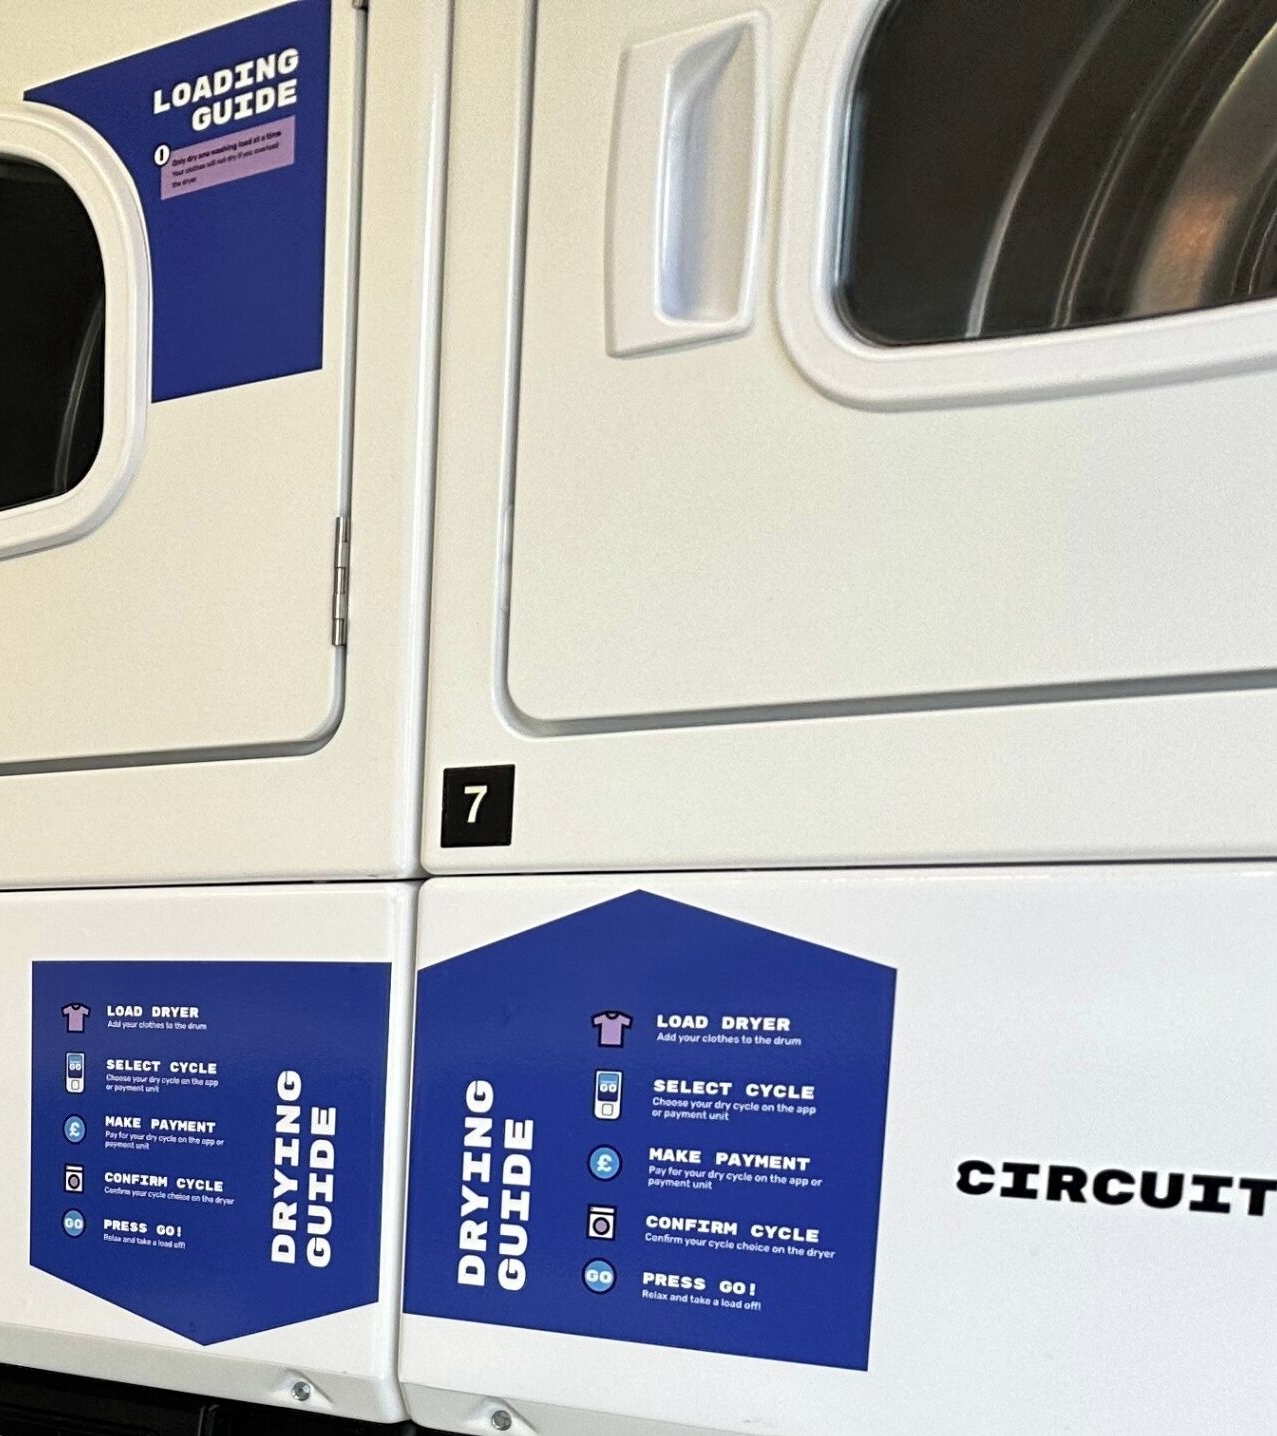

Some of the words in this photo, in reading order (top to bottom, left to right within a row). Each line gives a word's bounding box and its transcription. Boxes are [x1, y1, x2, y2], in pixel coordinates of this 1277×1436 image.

[153, 48, 299, 114] LOADING
[191, 79, 298, 132] GUIDE
[463, 785, 488, 823] 7
[107, 1005, 143, 1017] LOAD
[151, 1006, 198, 1018] DRYER
[656, 1014, 708, 1029] LOAD
[721, 1016, 790, 1031] DRYER
[656, 1032, 676, 1041] Add
[678, 1034, 700, 1043] your
[701, 1034, 739, 1044] clothes
[741, 1034, 753, 1044] to
[754, 1035, 772, 1045] the
[773, 1036, 802, 1045] drum
[106, 1059, 161, 1071] SELECT
[169, 1061, 217, 1074] CYCLE
[653, 1079, 732, 1095] SELECT
[745, 1083, 814, 1099] CYCLE
[651, 1109, 662, 1117] or
[663, 1110, 707, 1119] payment
[708, 1111, 729, 1121] unit
[652, 1096, 689, 1107] Choose
[690, 1100, 713, 1110] your
[714, 1100, 731, 1111] dry
[732, 1101, 759, 1112] cycle
[761, 1104, 775, 1112] on
[776, 1103, 794, 1113] the
[796, 1106, 816, 1116] app
[105, 1115, 141, 1128] MAKE
[151, 1118, 215, 1133] PAYMENT
[271, 1070, 302, 1264] DRYING
[649, 1147, 701, 1163] MAKE
[715, 1152, 810, 1170] PAYMENT
[104, 1172, 168, 1187] CONFIRM
[176, 1177, 223, 1192] CYCLE
[306, 1107, 336, 1268] GUIDE
[457, 1080, 494, 1287] DRYING
[955, 1159, 1277, 1217] CIRCUIT
[498, 1119, 534, 1291] GUIDE
[64, 1218, 83, 1229] GO
[103, 1219, 147, 1233] PRESS
[156, 1224, 181, 1237] GO!
[646, 1215, 737, 1235] CONFIRM
[750, 1224, 819, 1243] CYCLE
[644, 1232, 683, 1244] Confirm
[684, 1238, 707, 1246] your
[708, 1240, 734, 1249] cycle
[736, 1241, 770, 1252] choice
[787, 1245, 805, 1256] the
[806, 1248, 835, 1259] dryer
[586, 1269, 612, 1285] GO
[642, 1272, 705, 1290] PRESS
[719, 1280, 755, 1296] GO!
